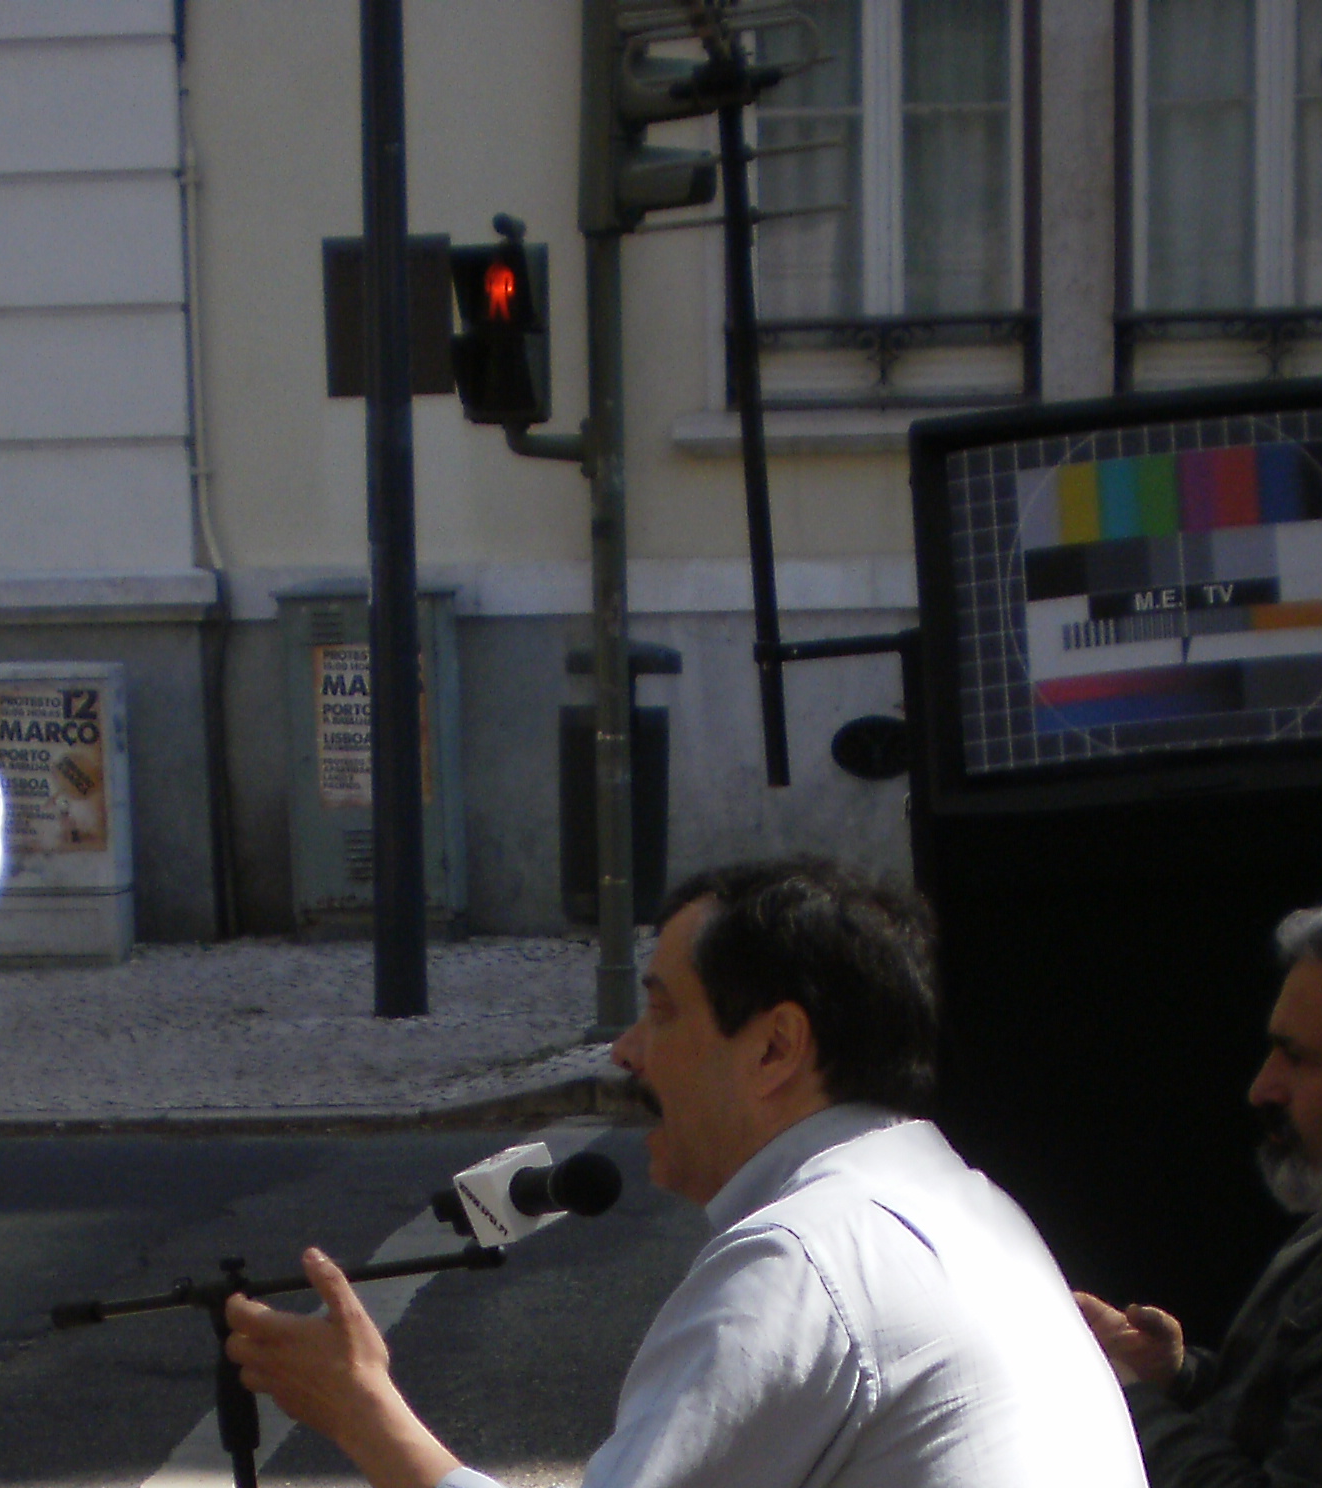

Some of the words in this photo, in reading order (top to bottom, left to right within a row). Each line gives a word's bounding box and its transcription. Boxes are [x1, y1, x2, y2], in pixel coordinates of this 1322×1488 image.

[1203, 584, 1234, 604] TV
[60, 689, 97, 719] 12
[0, 719, 99, 746] MARÇO
[0, 748, 51, 761] PORTO
